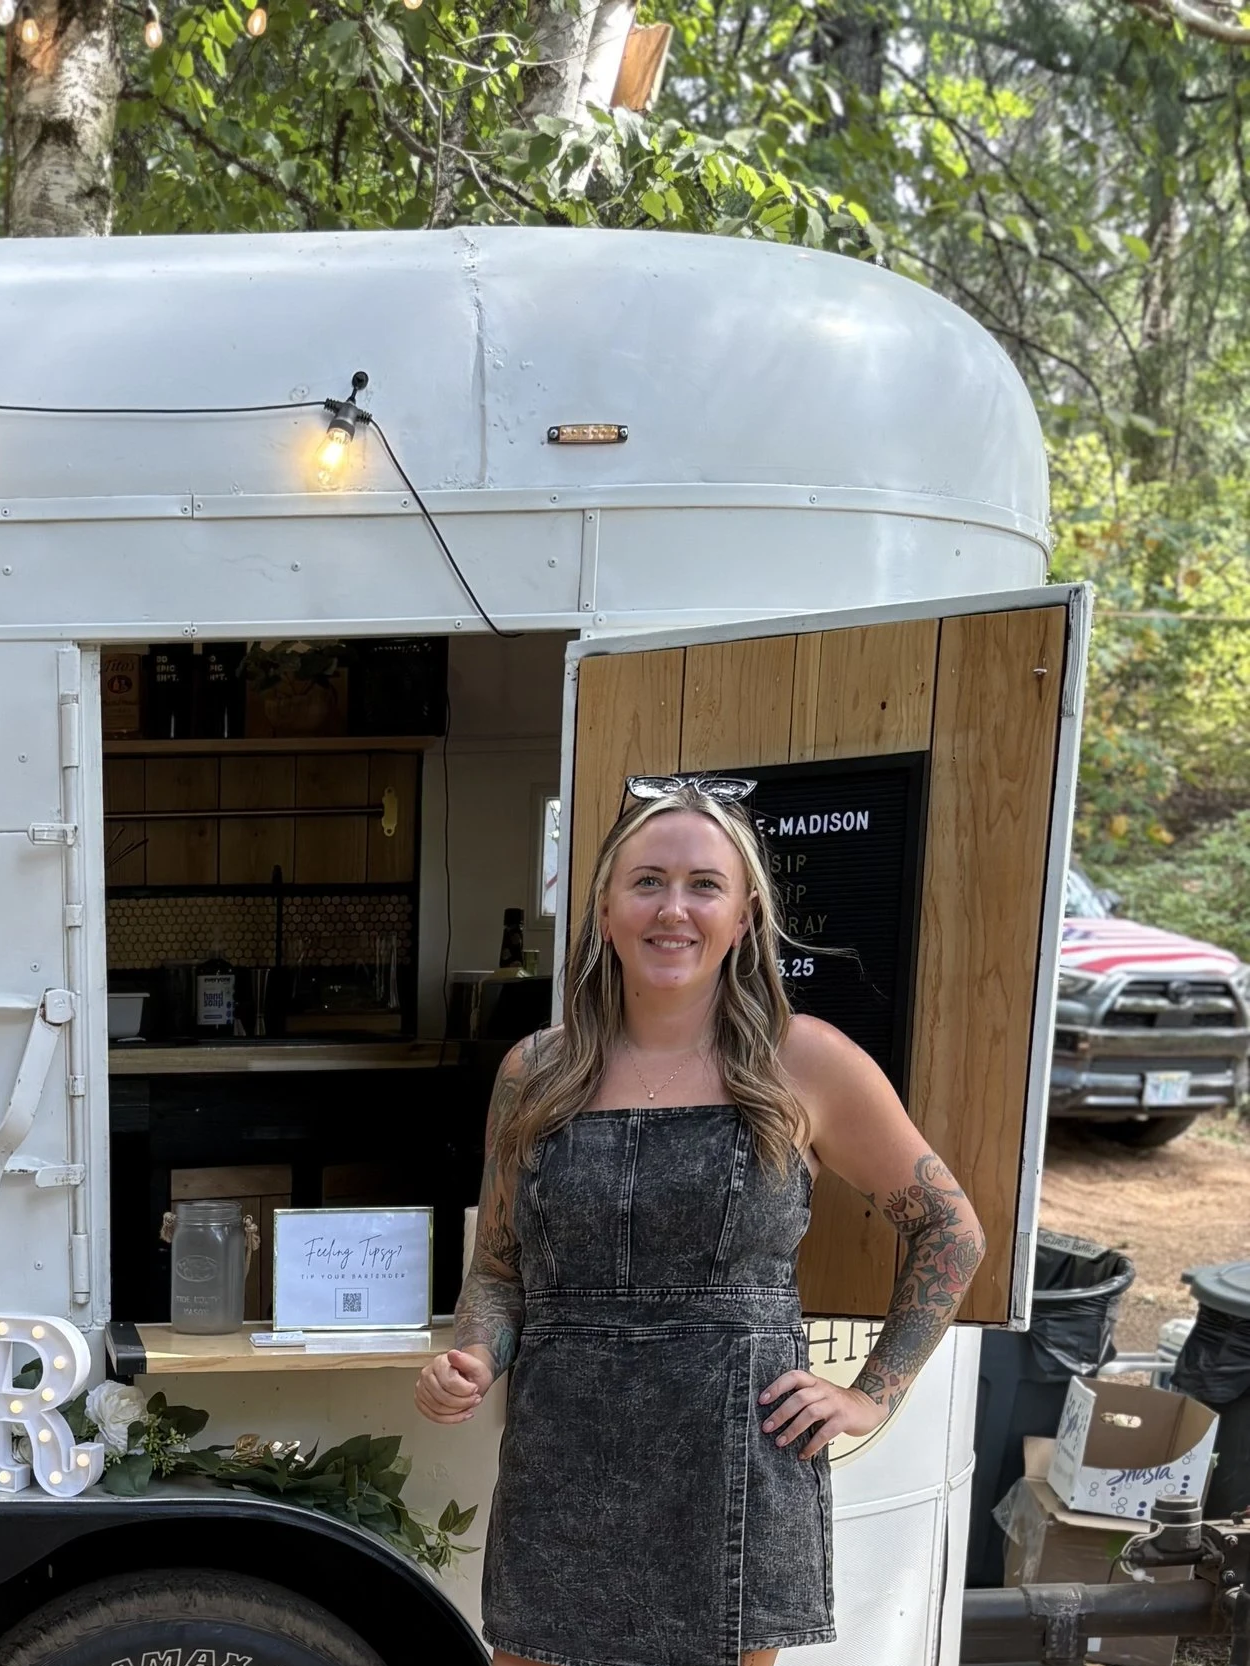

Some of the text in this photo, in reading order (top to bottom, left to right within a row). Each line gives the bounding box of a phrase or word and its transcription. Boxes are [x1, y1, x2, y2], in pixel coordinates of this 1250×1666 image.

[771, 854, 807, 873] SIP
[788, 914, 828, 934] RAY
[204, 991, 223, 1000] hand
[204, 999, 223, 1009] soap
[304, 1234, 403, 1271] Feeling Tipsy?
[351, 1272, 406, 1280] BARTENDER
